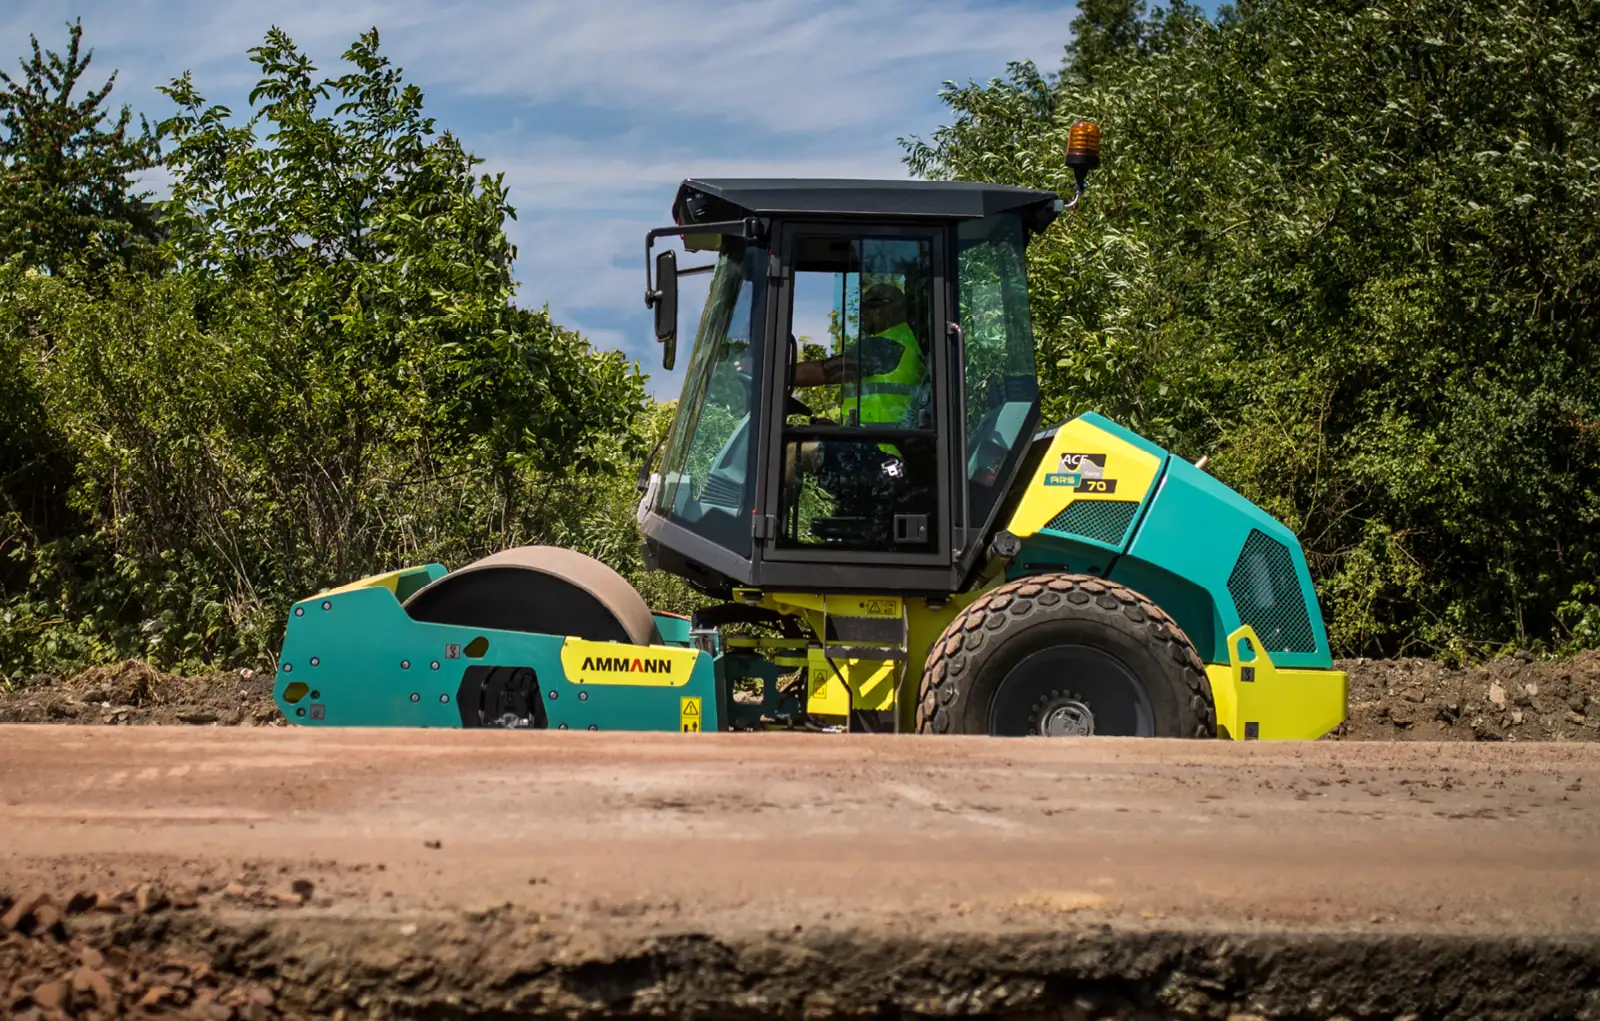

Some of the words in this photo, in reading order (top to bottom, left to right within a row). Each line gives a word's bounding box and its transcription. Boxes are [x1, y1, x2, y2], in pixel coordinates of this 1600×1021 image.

[1050, 476, 1075, 484] ARS
[1087, 481, 1107, 491] 70
[581, 657, 672, 673] AMMANN
